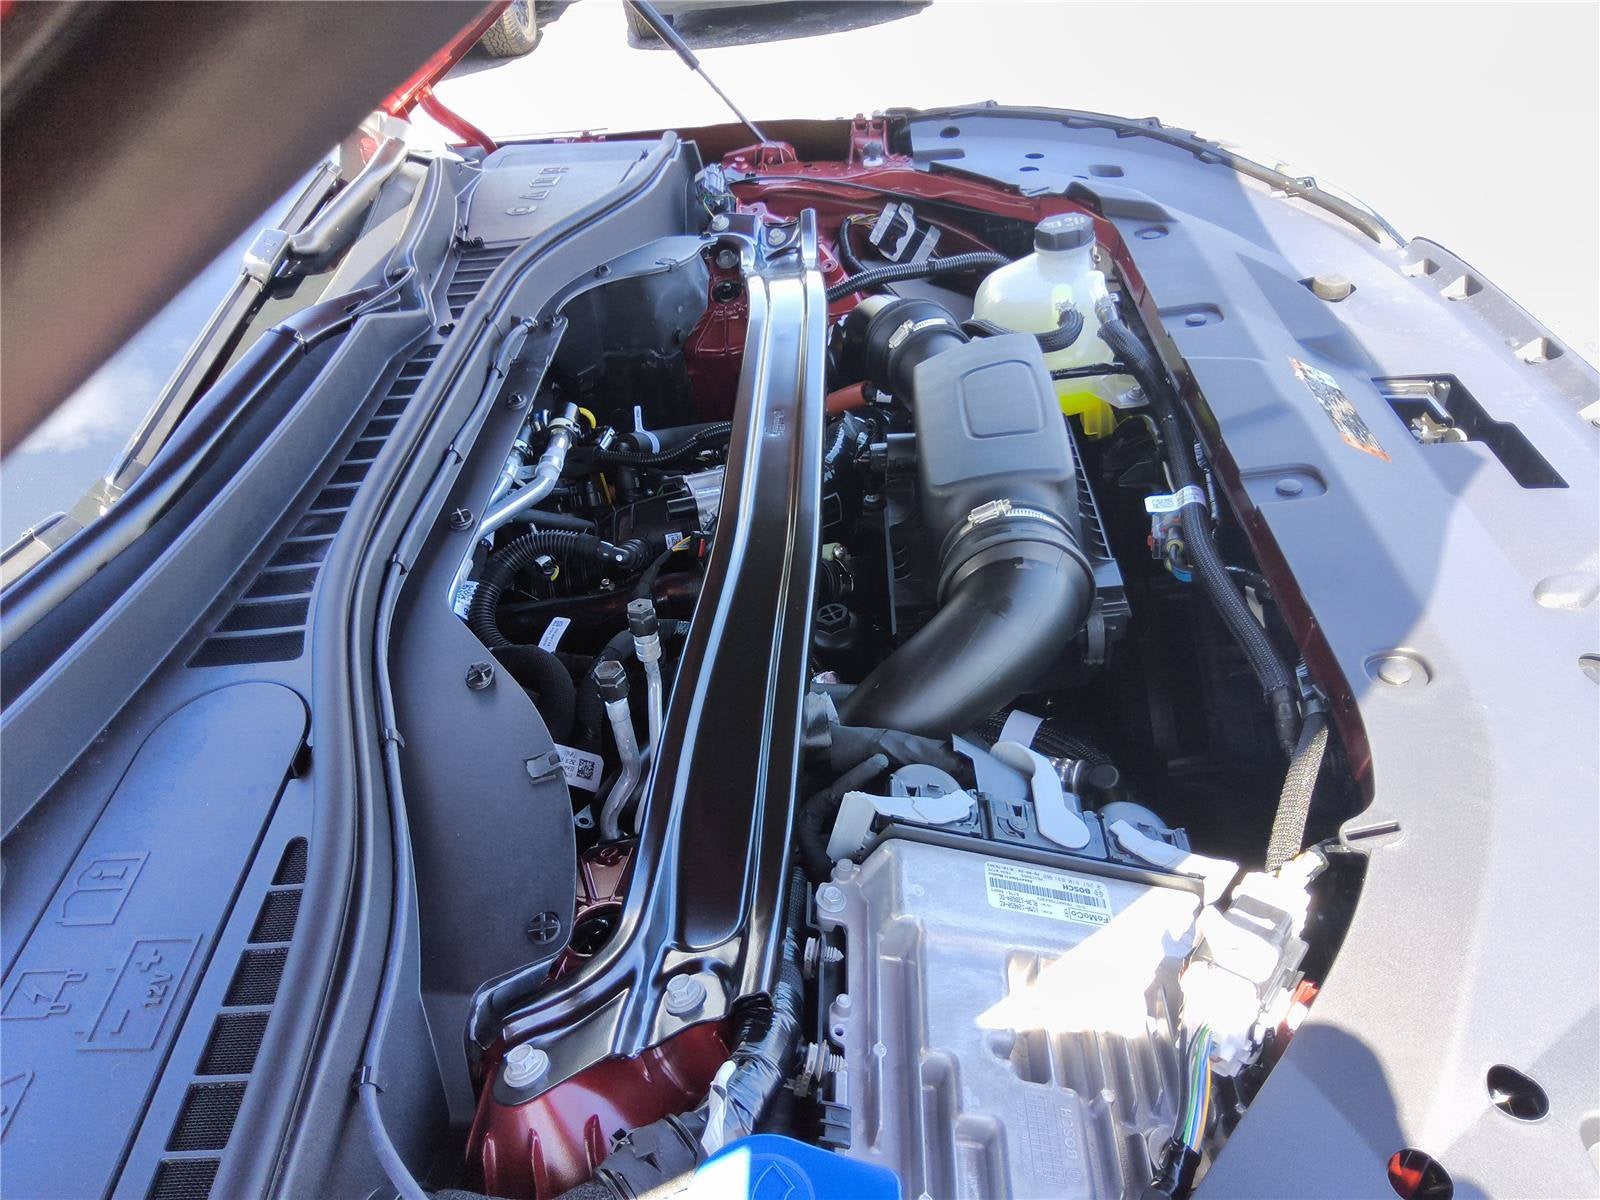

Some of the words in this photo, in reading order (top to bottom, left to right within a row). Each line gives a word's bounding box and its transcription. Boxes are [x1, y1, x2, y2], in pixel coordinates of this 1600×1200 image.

[1063, 884, 1091, 894] BOSCH
[1070, 911, 1109, 924] FoMoCo
[144, 972, 173, 1008] 12V
[1060, 1107, 1078, 1159] BOSCH
